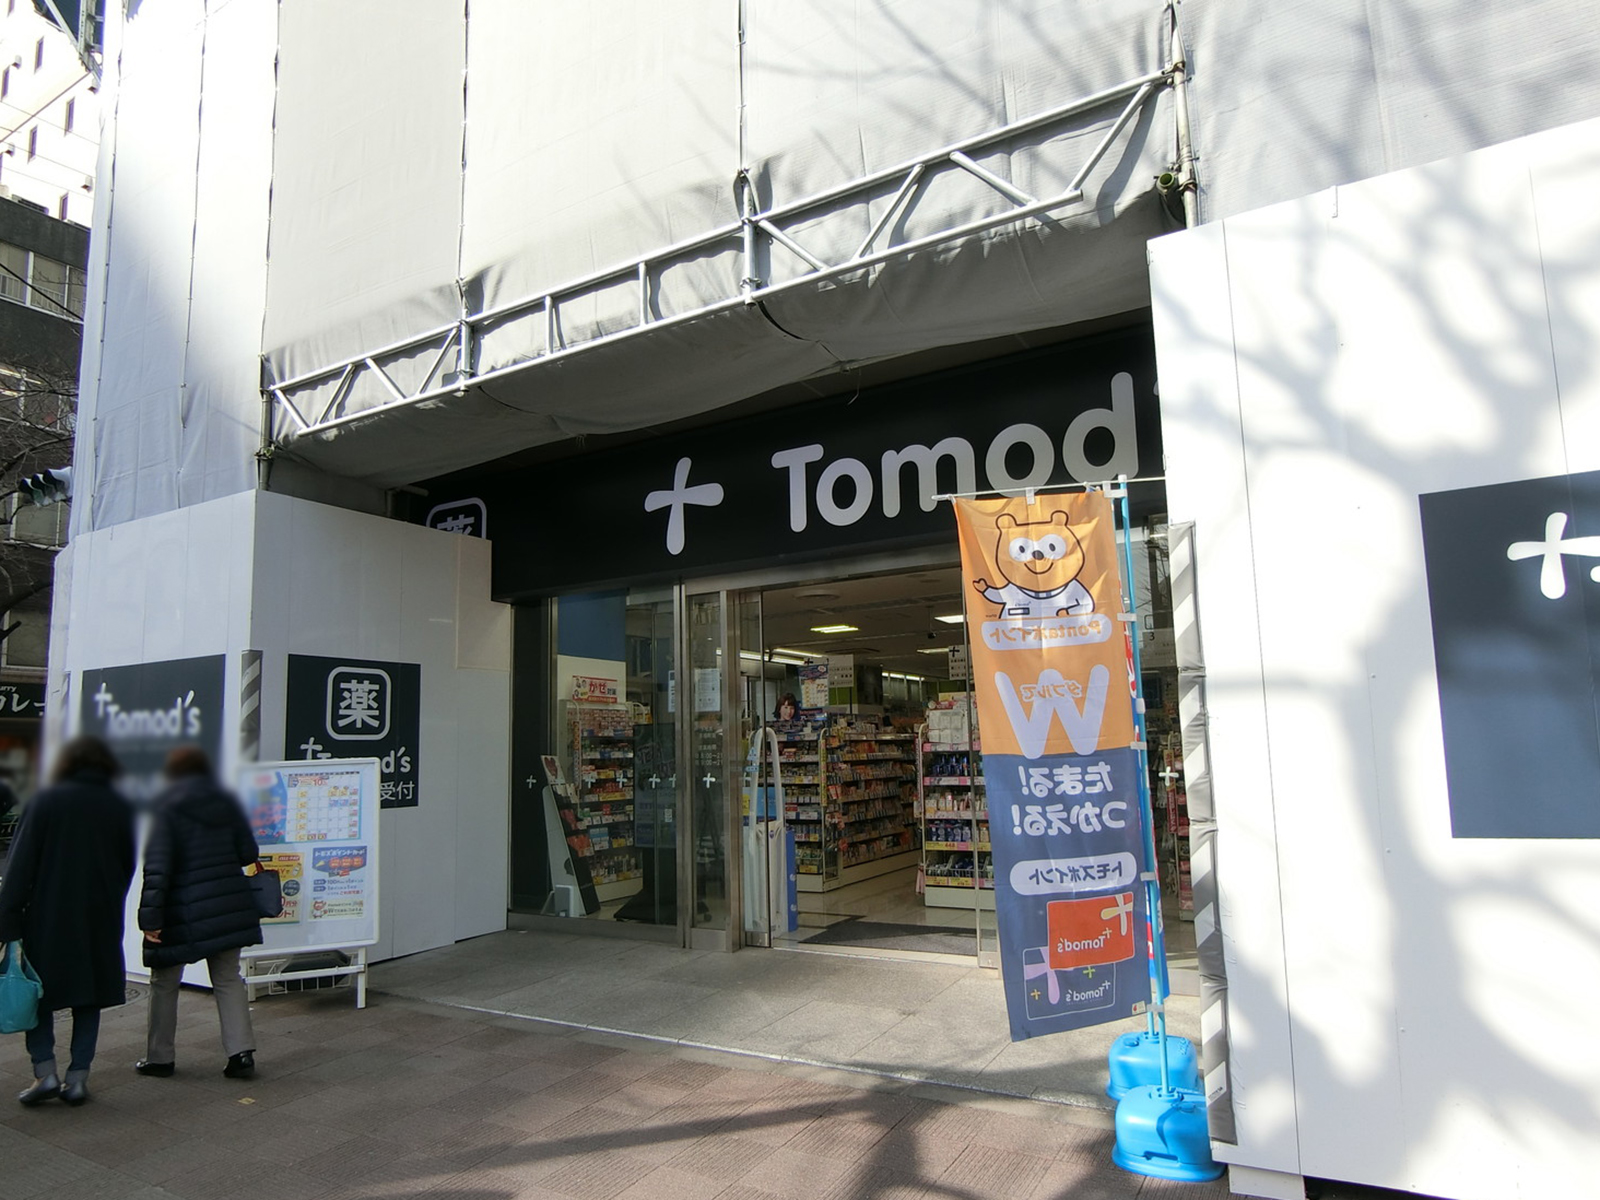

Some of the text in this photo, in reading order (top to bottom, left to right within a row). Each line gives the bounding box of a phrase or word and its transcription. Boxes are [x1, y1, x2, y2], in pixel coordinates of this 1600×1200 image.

[771, 371, 1159, 533] Tomod
[104, 690, 202, 738] Tomod's
[337, 679, 380, 729] 薬
[380, 781, 415, 801] 受付
